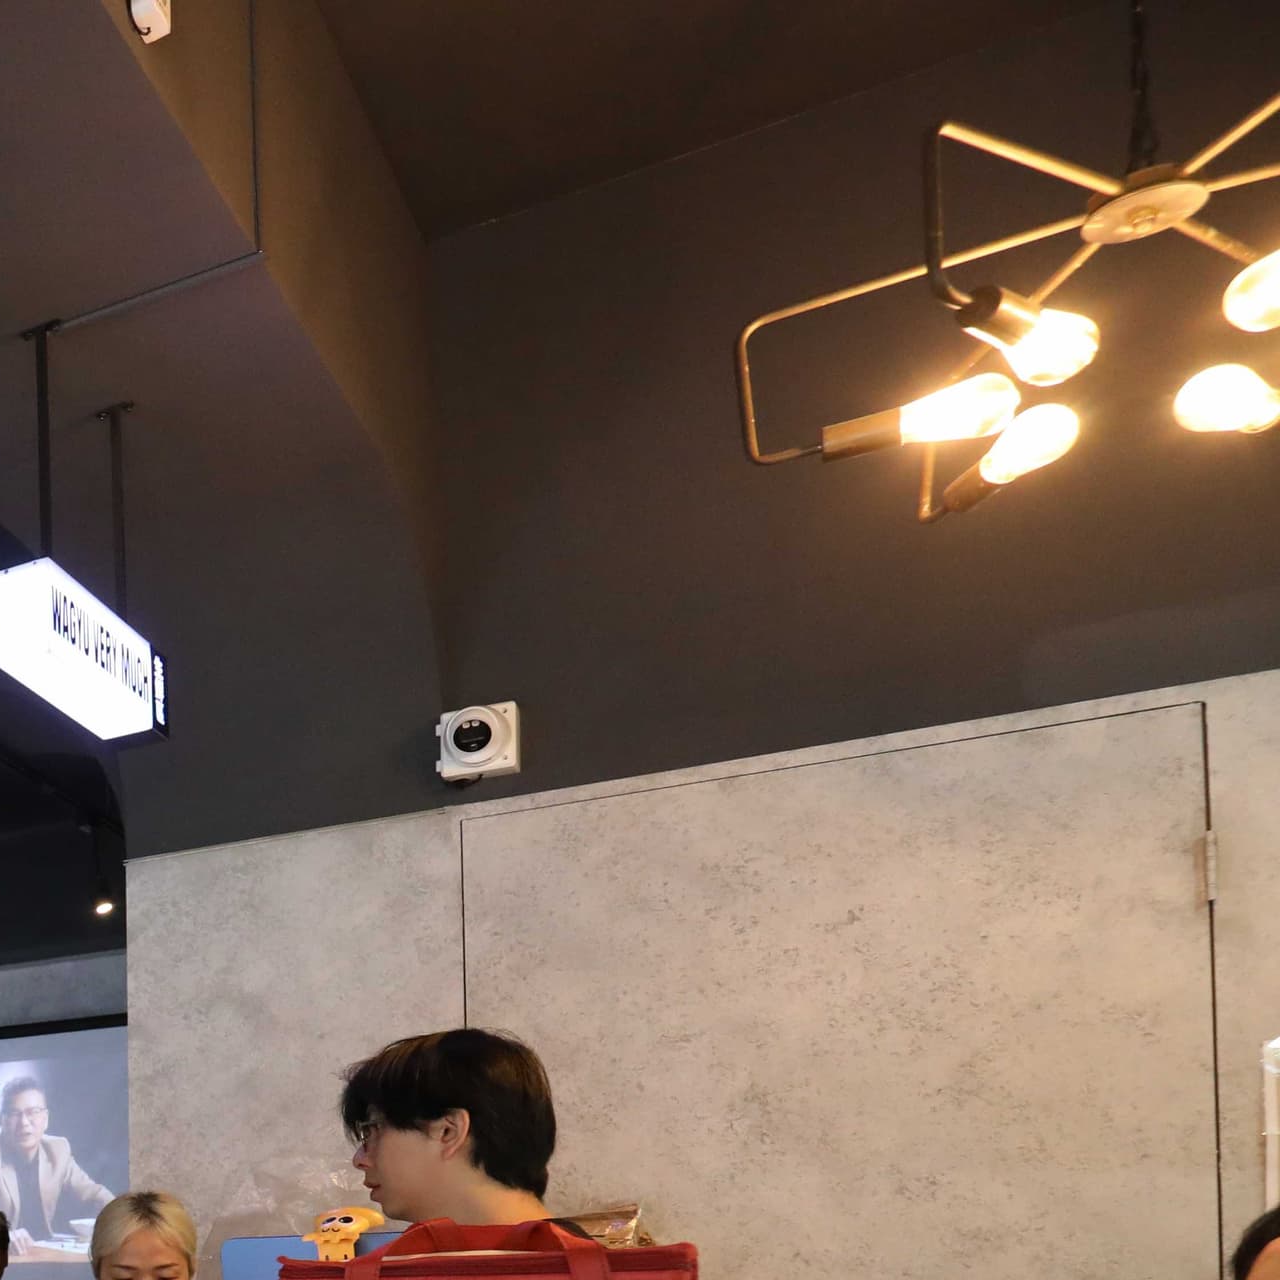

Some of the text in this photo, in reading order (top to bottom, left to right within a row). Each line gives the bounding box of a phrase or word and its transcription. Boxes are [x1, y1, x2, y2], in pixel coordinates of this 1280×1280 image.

[51, 584, 149, 703] WAGYU VERY MUCH
